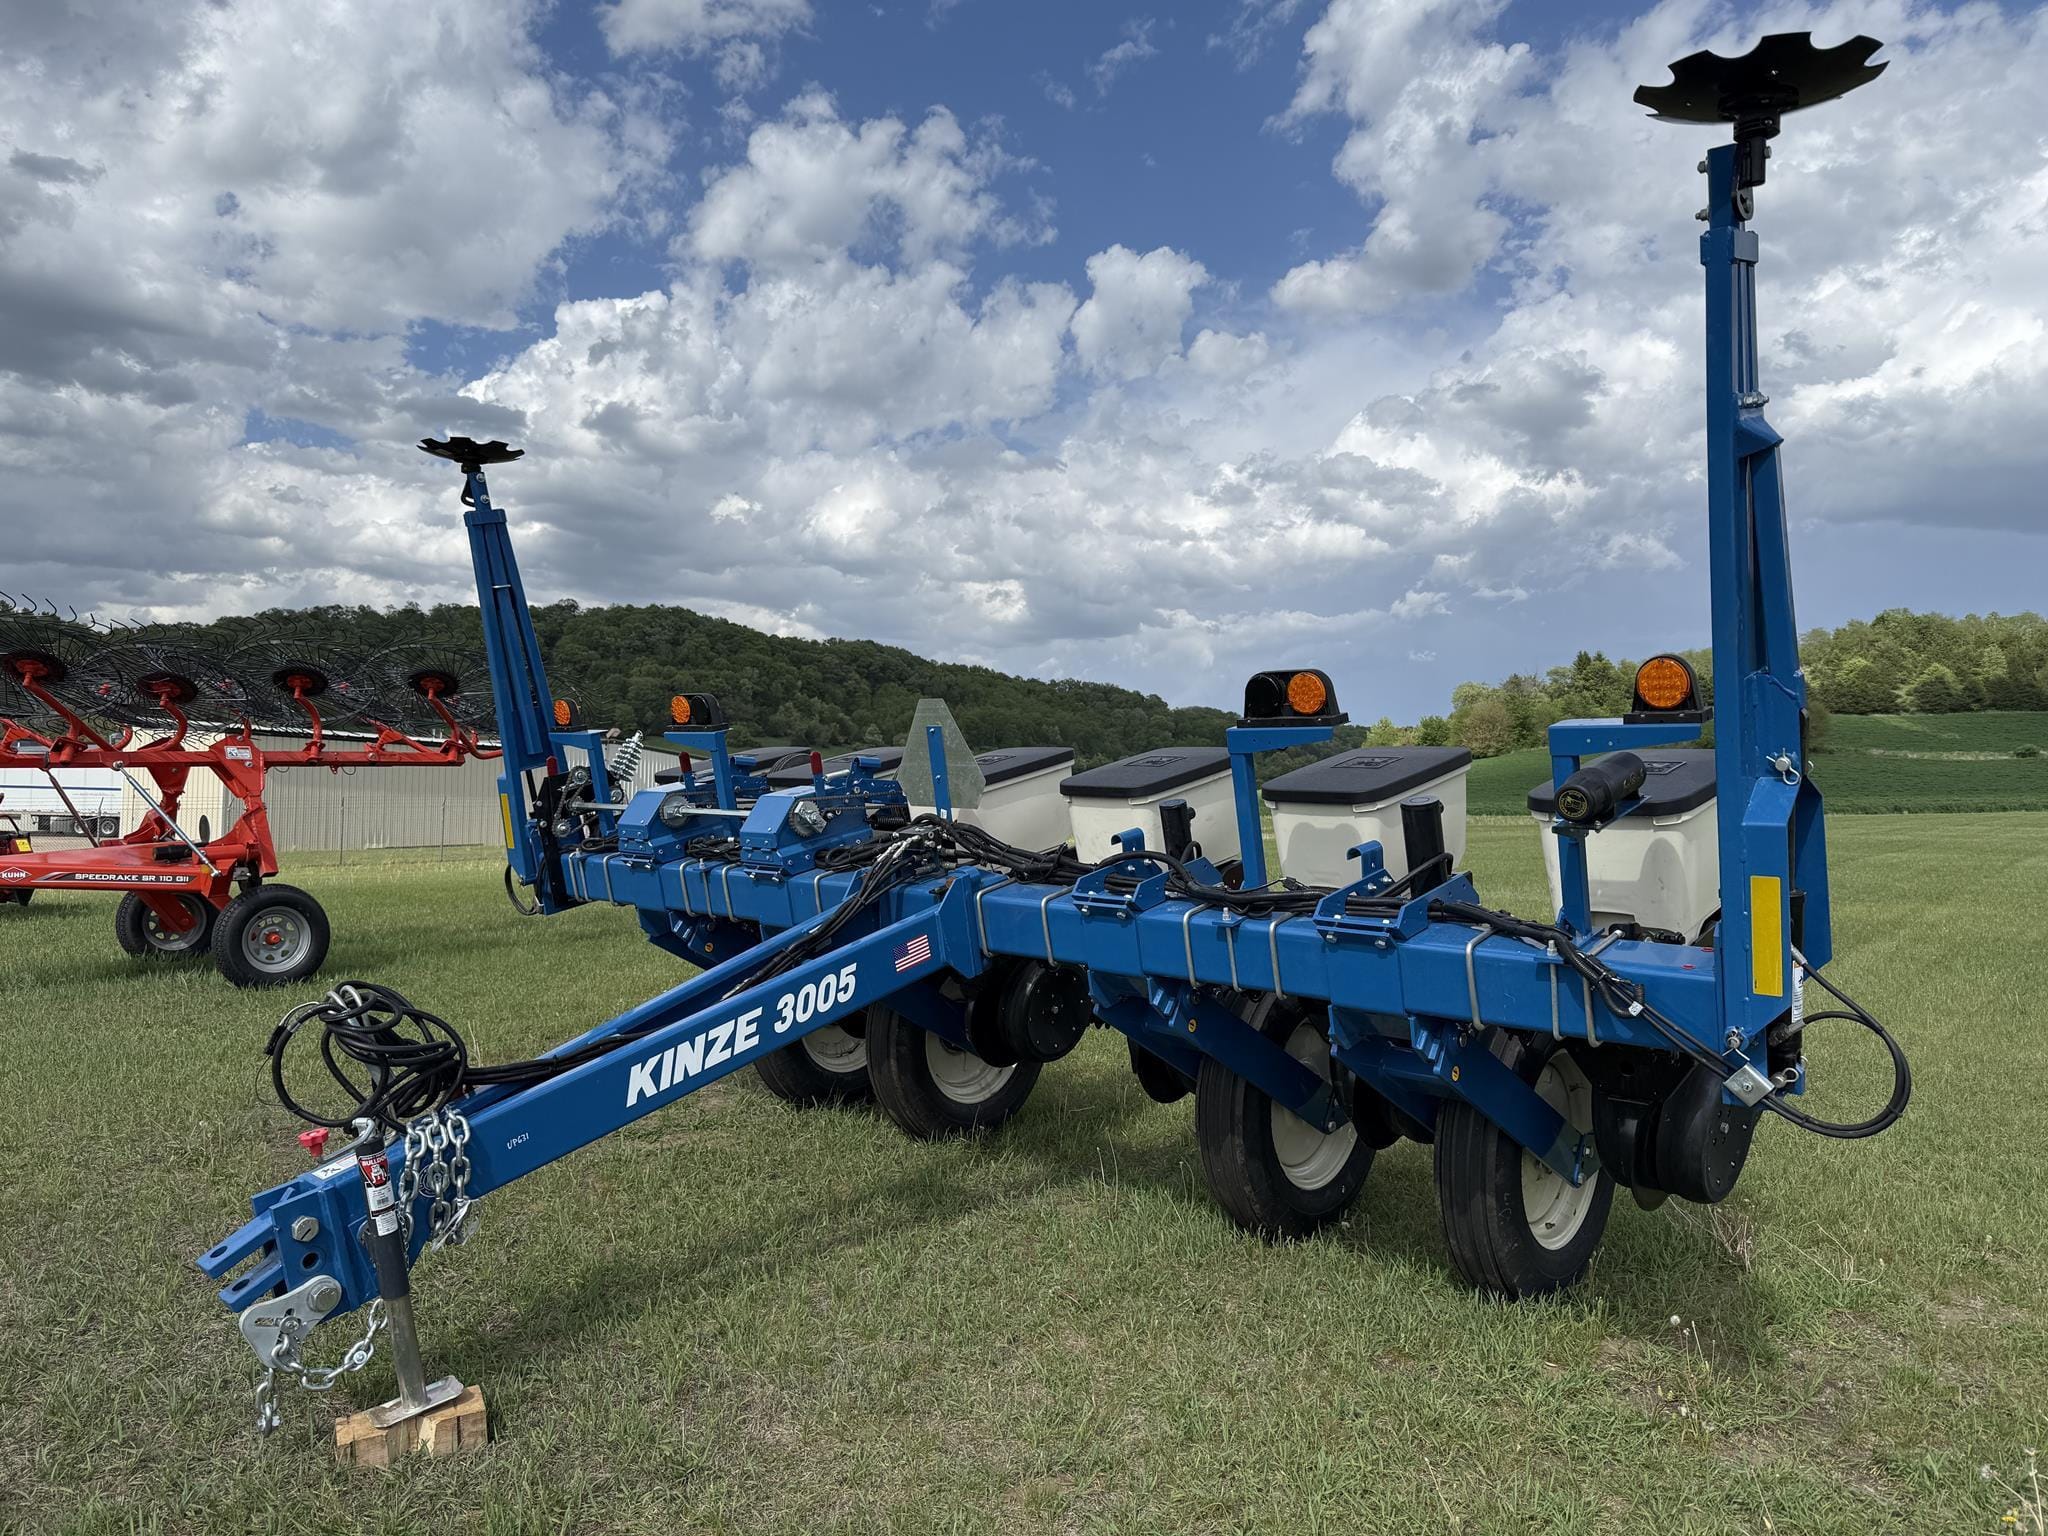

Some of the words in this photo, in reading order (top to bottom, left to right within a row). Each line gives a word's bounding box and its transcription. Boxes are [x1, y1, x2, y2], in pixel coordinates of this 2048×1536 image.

[75, 873, 139, 881] SPEEDRAKE
[626, 1007, 763, 1108] KINZE
[773, 962, 857, 1034] 3005
